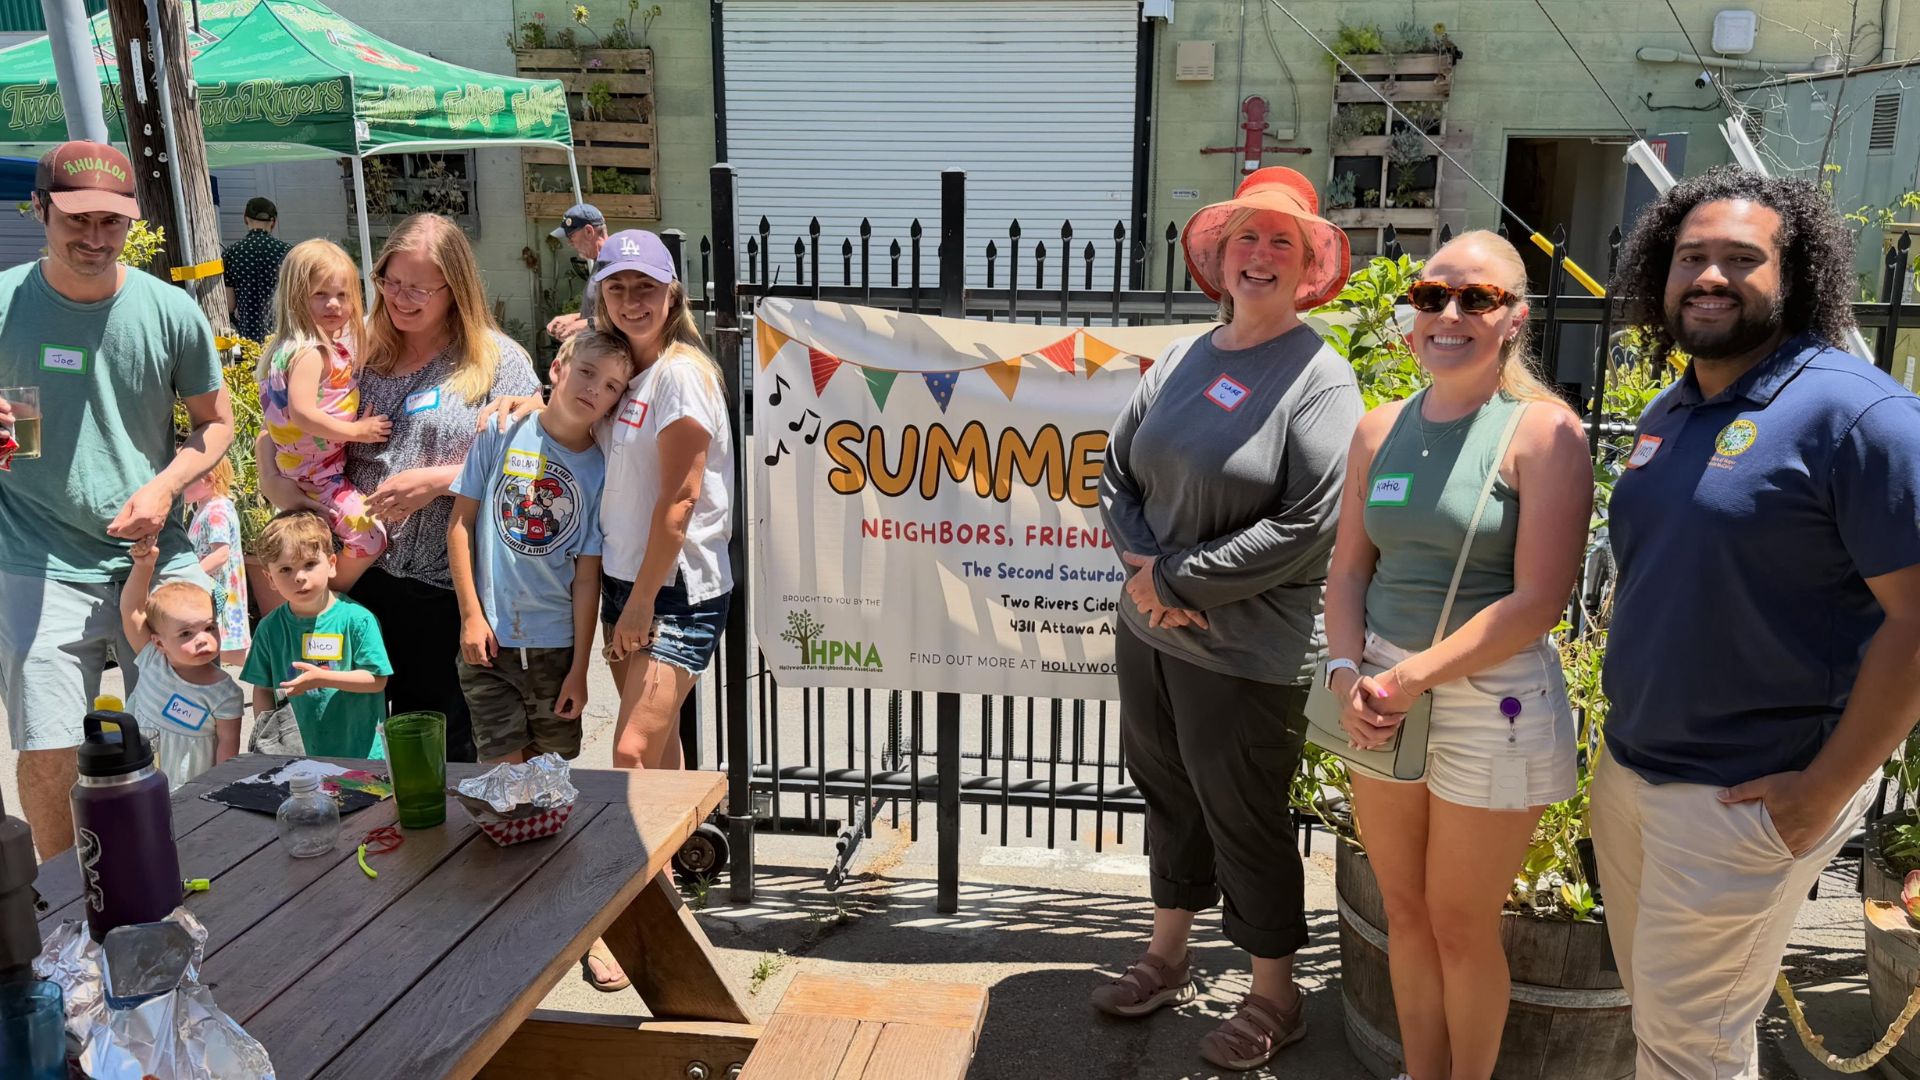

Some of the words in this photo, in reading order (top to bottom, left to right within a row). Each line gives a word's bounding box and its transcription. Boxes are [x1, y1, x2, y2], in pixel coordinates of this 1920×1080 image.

[620, 236, 640, 256] LA
[51, 353, 76, 366] Joe
[1376, 480, 1401, 492] Katie
[861, 517, 1014, 547] NEIGHBORS,
[527, 545, 549, 554] KART
[962, 561, 992, 578] The
[998, 563, 1054, 580] Second
[1060, 564, 1127, 583] Saturda
[782, 594, 820, 604] BROUGHT
[823, 596, 833, 604] TO
[836, 597, 851, 605] YOU
[853, 598, 863, 606] BY
[866, 598, 881, 607] THE
[1001, 594, 1030, 609] Two
[1034, 595, 1079, 611] Rivers
[1010, 619, 1036, 633] 4311
[1040, 620, 1095, 635] Attawa
[307, 639, 333, 654] Nico
[810, 639, 883, 667] HPNA
[910, 652, 941, 665] FIND
[946, 654, 973, 666] OUT
[977, 656, 1015, 669] MORE
[1020, 659, 1037, 670] AT
[172, 701, 192, 718] Beni
